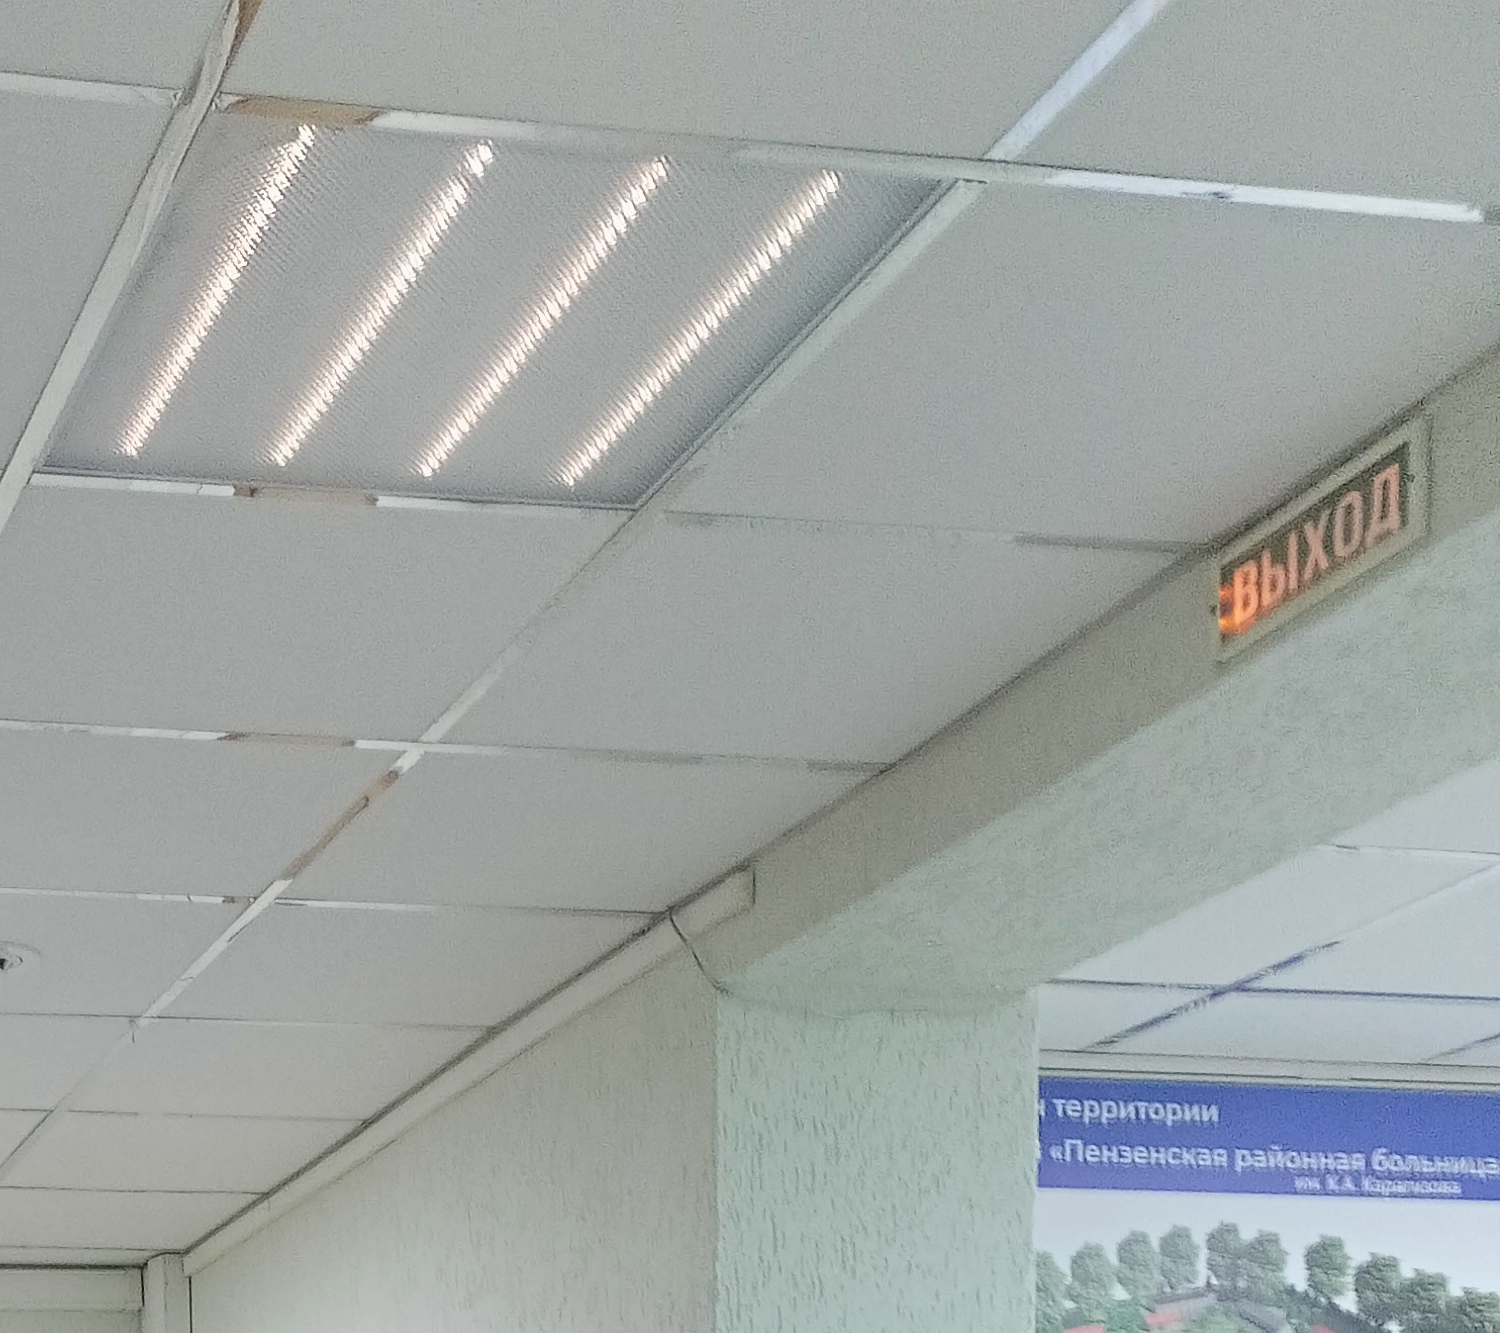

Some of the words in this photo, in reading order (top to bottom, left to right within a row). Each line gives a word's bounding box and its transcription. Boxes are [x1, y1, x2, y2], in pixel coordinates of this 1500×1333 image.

[1233, 463, 1400, 625] ВЫХОД
[1051, 1098, 1220, 1126] территории
[1049, 1138, 1228, 1167] «Пензенская
[1234, 1144, 1366, 1172] районная
